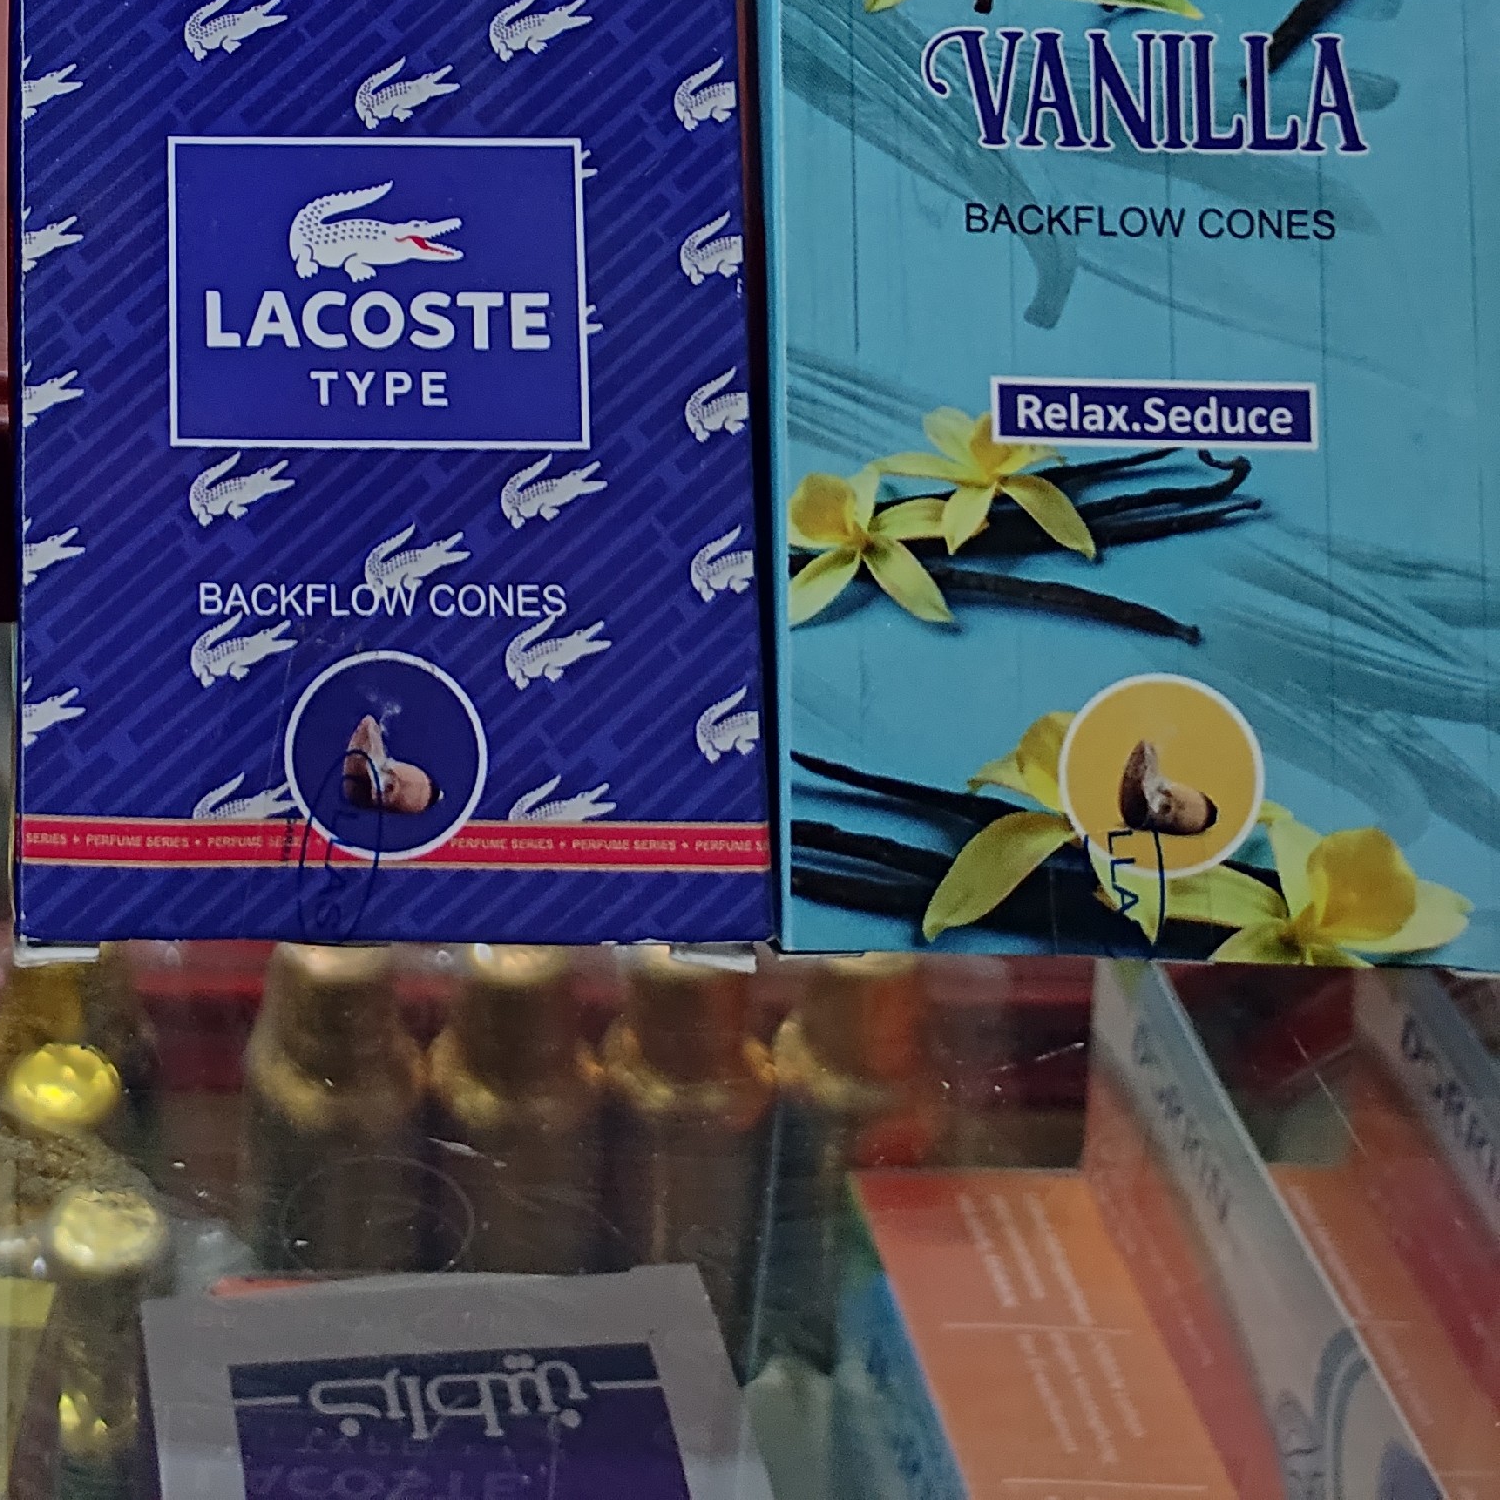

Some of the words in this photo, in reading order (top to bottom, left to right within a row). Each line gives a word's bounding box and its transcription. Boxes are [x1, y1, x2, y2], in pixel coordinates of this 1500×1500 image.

[920, 26, 1369, 154] VANILLA
[963, 202, 1186, 239] BACKFLOW
[1197, 207, 1337, 242] CONES
[204, 289, 552, 351] LACOSTE
[309, 369, 450, 408] TYPE
[1015, 390, 1294, 437] Relax.Seduce
[198, 580, 416, 619] BACKFLOW
[428, 583, 567, 619] CONES
[308, 1352, 589, 1440] خراطين
